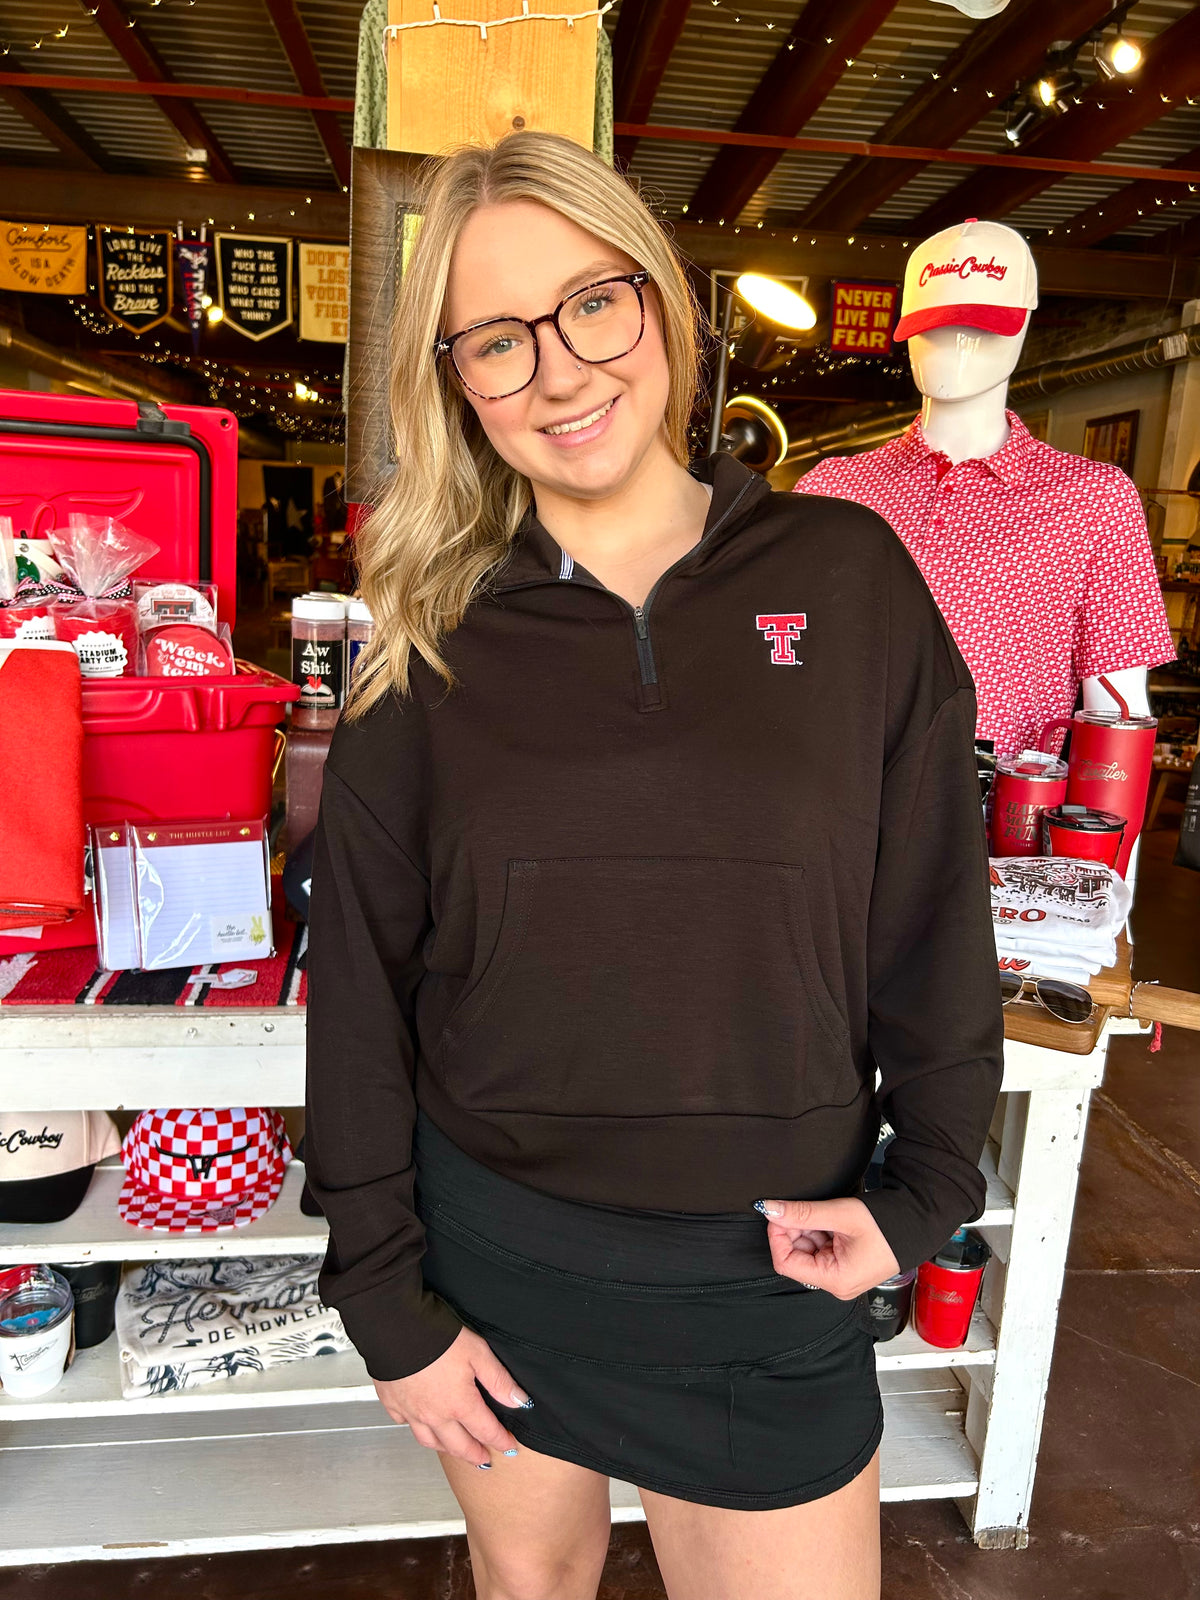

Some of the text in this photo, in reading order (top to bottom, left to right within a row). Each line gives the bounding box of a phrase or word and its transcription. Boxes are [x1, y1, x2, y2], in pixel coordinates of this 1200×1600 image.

[7, 228, 72, 252] Comfort
[106, 239, 163, 256] LONG LIVE
[127, 252, 144, 262] THE
[233, 248, 275, 261] WHO THE
[9, 257, 39, 285] SLOW
[106, 263, 166, 280] Reckless
[231, 261, 277, 273] FUCK ARE
[260, 275, 278, 285] AND
[318, 268, 349, 284] LOS
[118, 283, 155, 294] AND THE
[228, 284, 280, 297] WHO CARES
[113, 294, 160, 311] Brave
[229, 297, 280, 310] WHAT THEY
[836, 288, 893, 309] NEVER
[835, 308, 890, 328] LIVE IN
[832, 328, 887, 349] FEAR
[79, 648, 117, 657] STADIUM
[155, 638, 226, 668] Wreck
[302, 642, 330, 657] Aw
[104, 654, 124, 663] CUPS
[301, 660, 331, 675] Shit
[1006, 814, 1037, 826] MOR
[1056, 914, 1090, 923] TEXAS
[7, 1126, 64, 1153] Cowboy
[209, 1327, 235, 1344] DE
